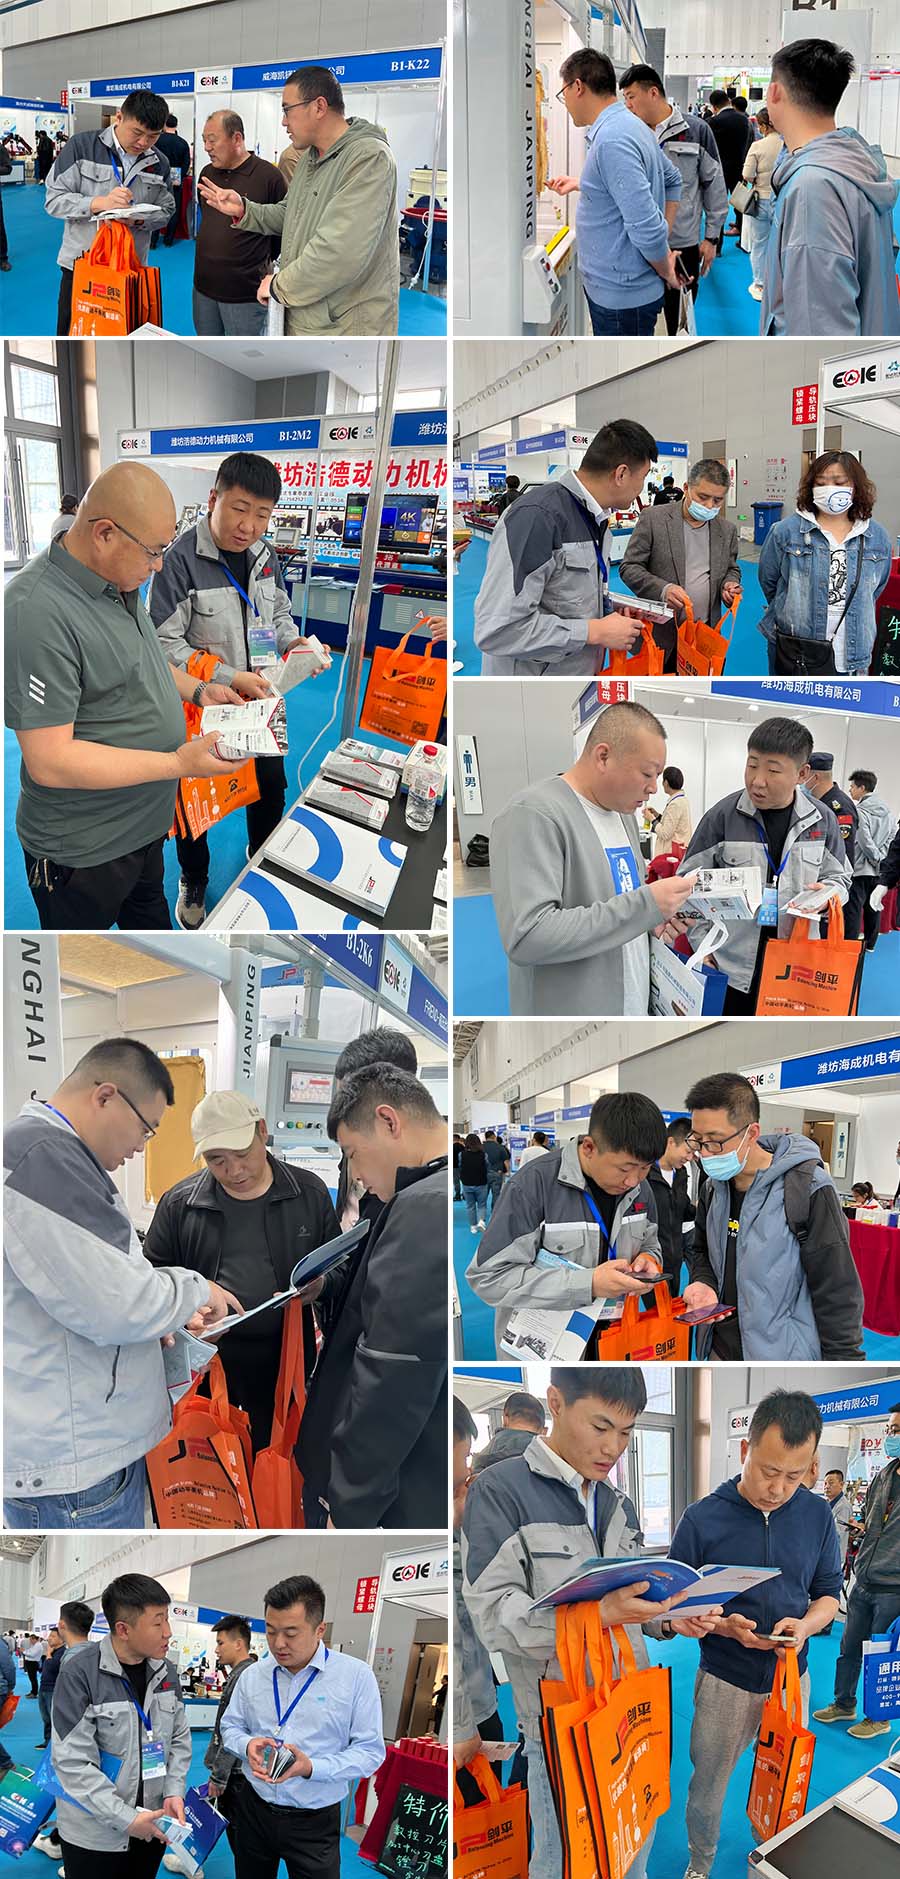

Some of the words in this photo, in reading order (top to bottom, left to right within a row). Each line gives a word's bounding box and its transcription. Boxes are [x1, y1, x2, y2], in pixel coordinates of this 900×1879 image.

[391, 59, 430, 71] B1-K22
[525, 110, 533, 239] JIANPING
[279, 430, 312, 442] B1-2M2
[400, 511, 416, 523] 4K
[465, 777, 476, 787] 男
[21, 938, 47, 1062] NGHAI
[243, 964, 256, 1078] JIANPING
[404, 1793, 448, 1836] 特价
